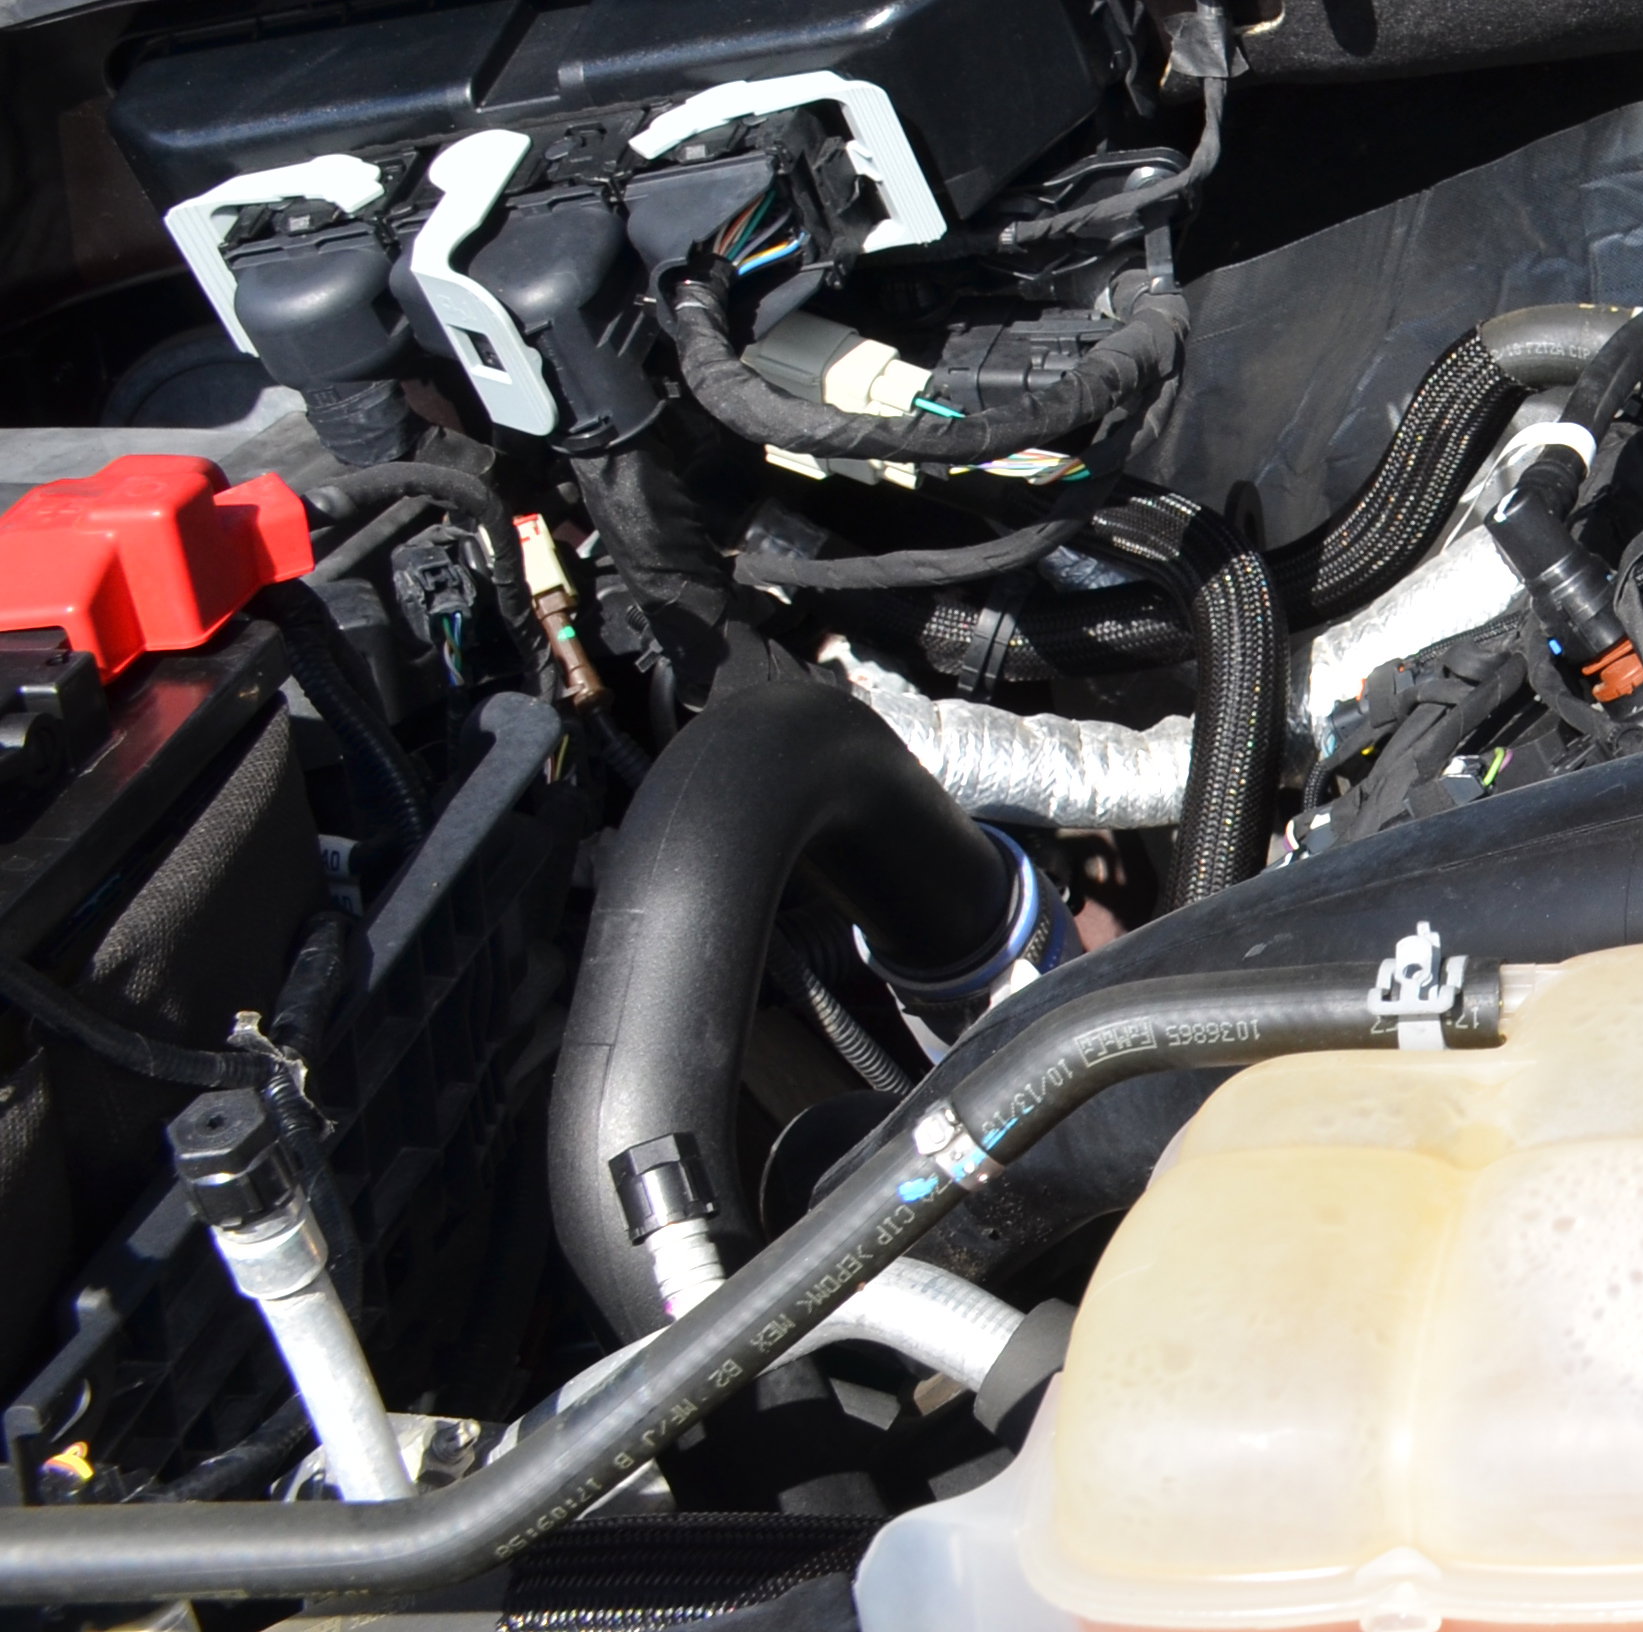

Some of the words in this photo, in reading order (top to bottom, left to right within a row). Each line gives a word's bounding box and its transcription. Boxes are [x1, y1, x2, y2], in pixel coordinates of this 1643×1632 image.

[1165, 1018, 1260, 1046] 1036865
[874, 1205, 916, 1247] CIP
[749, 1317, 798, 1354] MEX
[708, 1361, 744, 1389] B2
[495, 1476, 606, 1559] 17:09:58
